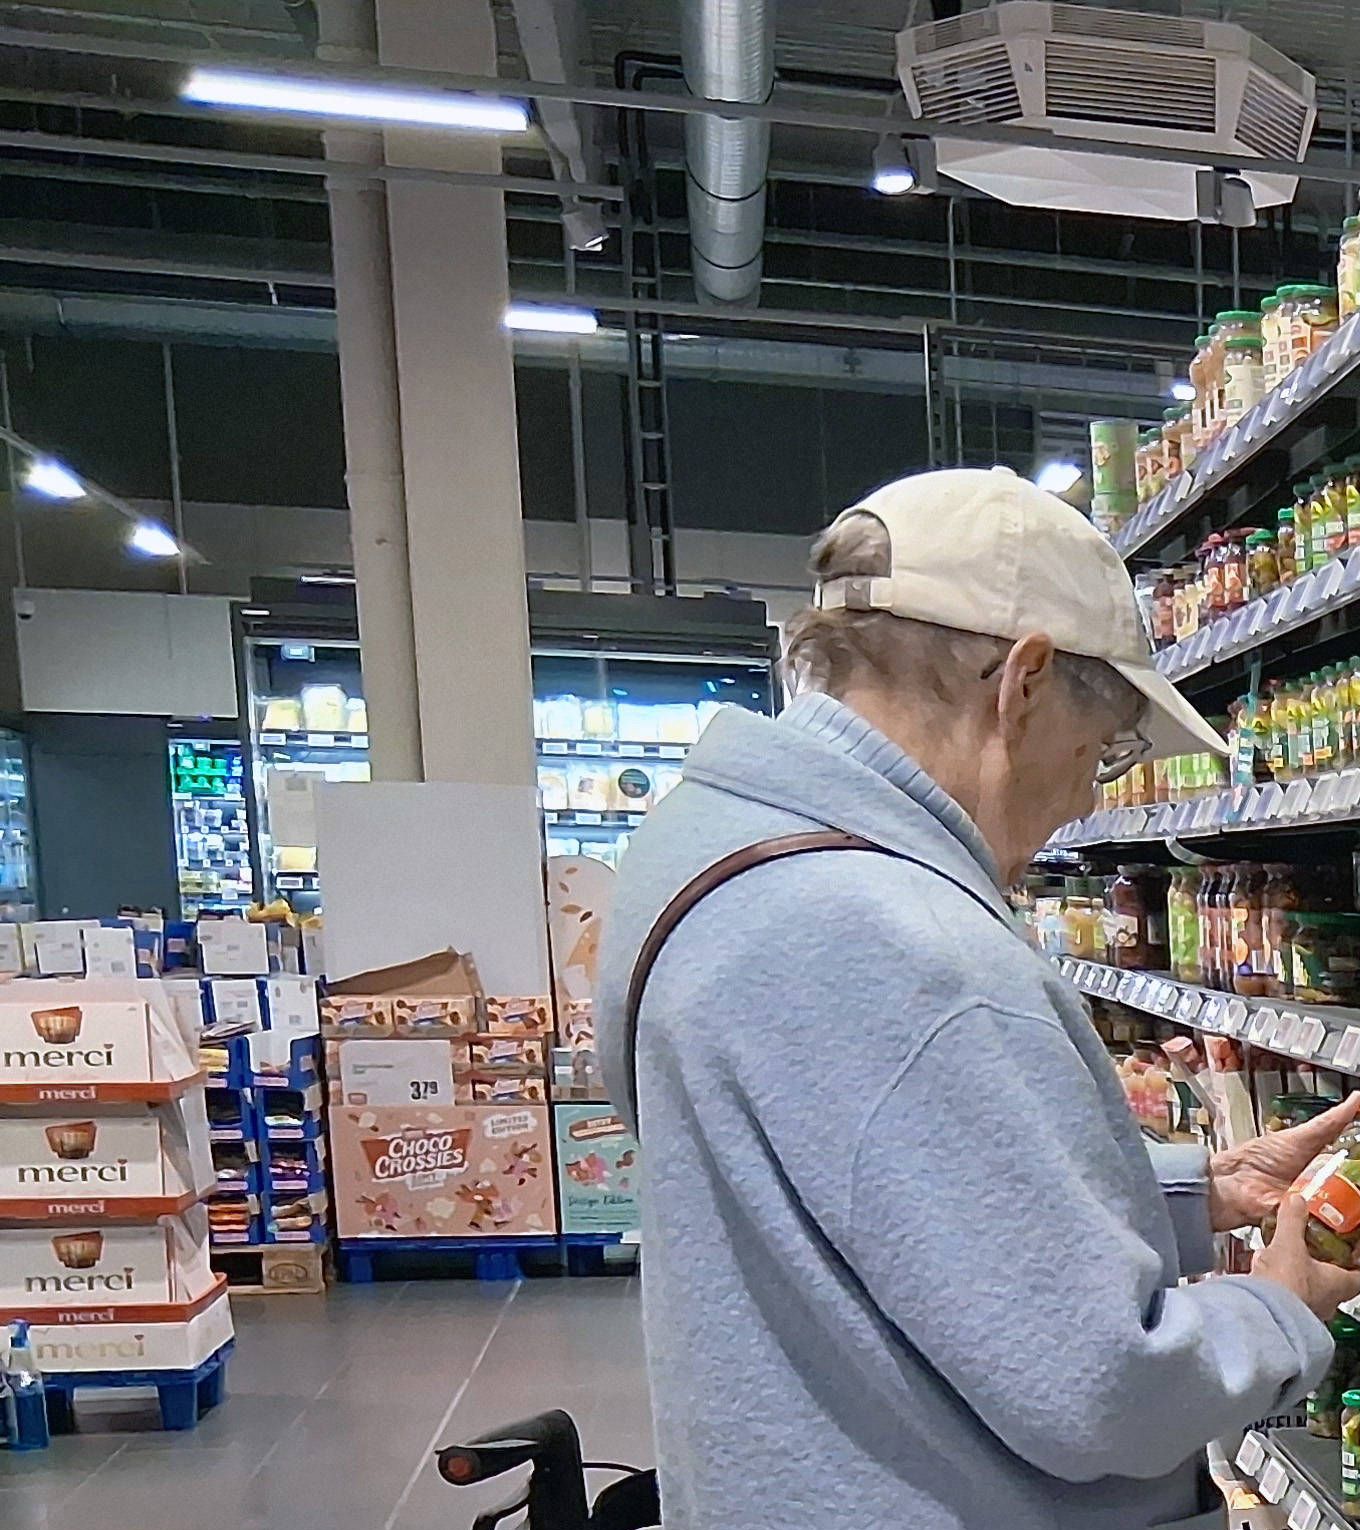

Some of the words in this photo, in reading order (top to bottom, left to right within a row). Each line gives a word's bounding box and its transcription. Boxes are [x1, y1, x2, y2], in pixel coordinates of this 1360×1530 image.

[4, 1042, 115, 1068] merci
[38, 1085, 97, 1101] merci
[387, 1135, 454, 1159] CHOCO
[18, 1158, 130, 1184] merci
[374, 1148, 466, 1180] CROSSIES
[48, 1199, 105, 1215] merci
[25, 1267, 135, 1294] merci
[58, 1307, 116, 1324] merci
[36, 1333, 146, 1360] merci
